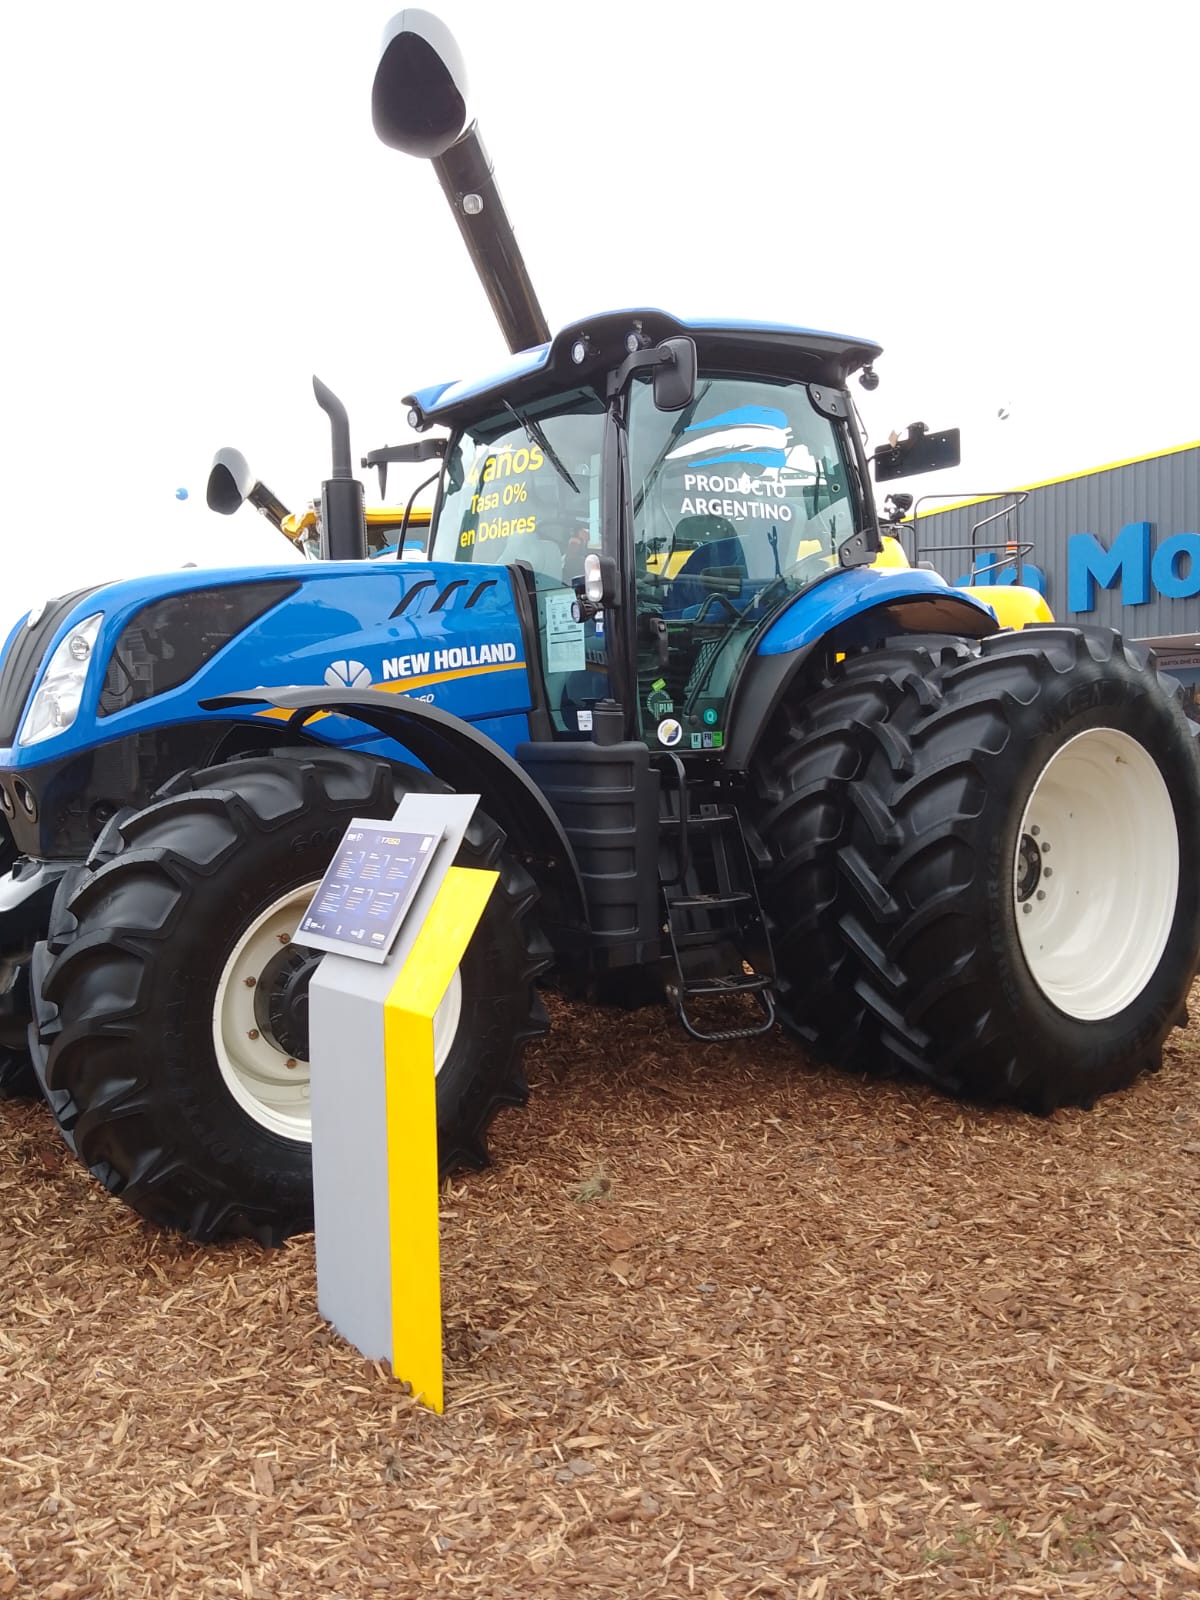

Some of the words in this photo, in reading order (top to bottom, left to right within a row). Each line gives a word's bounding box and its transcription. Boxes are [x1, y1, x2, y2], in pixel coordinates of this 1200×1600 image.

[482, 444, 544, 483] años
[471, 493, 498, 515] Tasa
[503, 481, 527, 506] 0%
[684, 474, 786, 498] PRODUCTO
[680, 497, 792, 522] ARGENTINO
[460, 528, 476, 547] en
[478, 515, 536, 543] Dólares
[381, 652, 430, 680] NEW
[433, 642, 516, 672] HOLLAND
